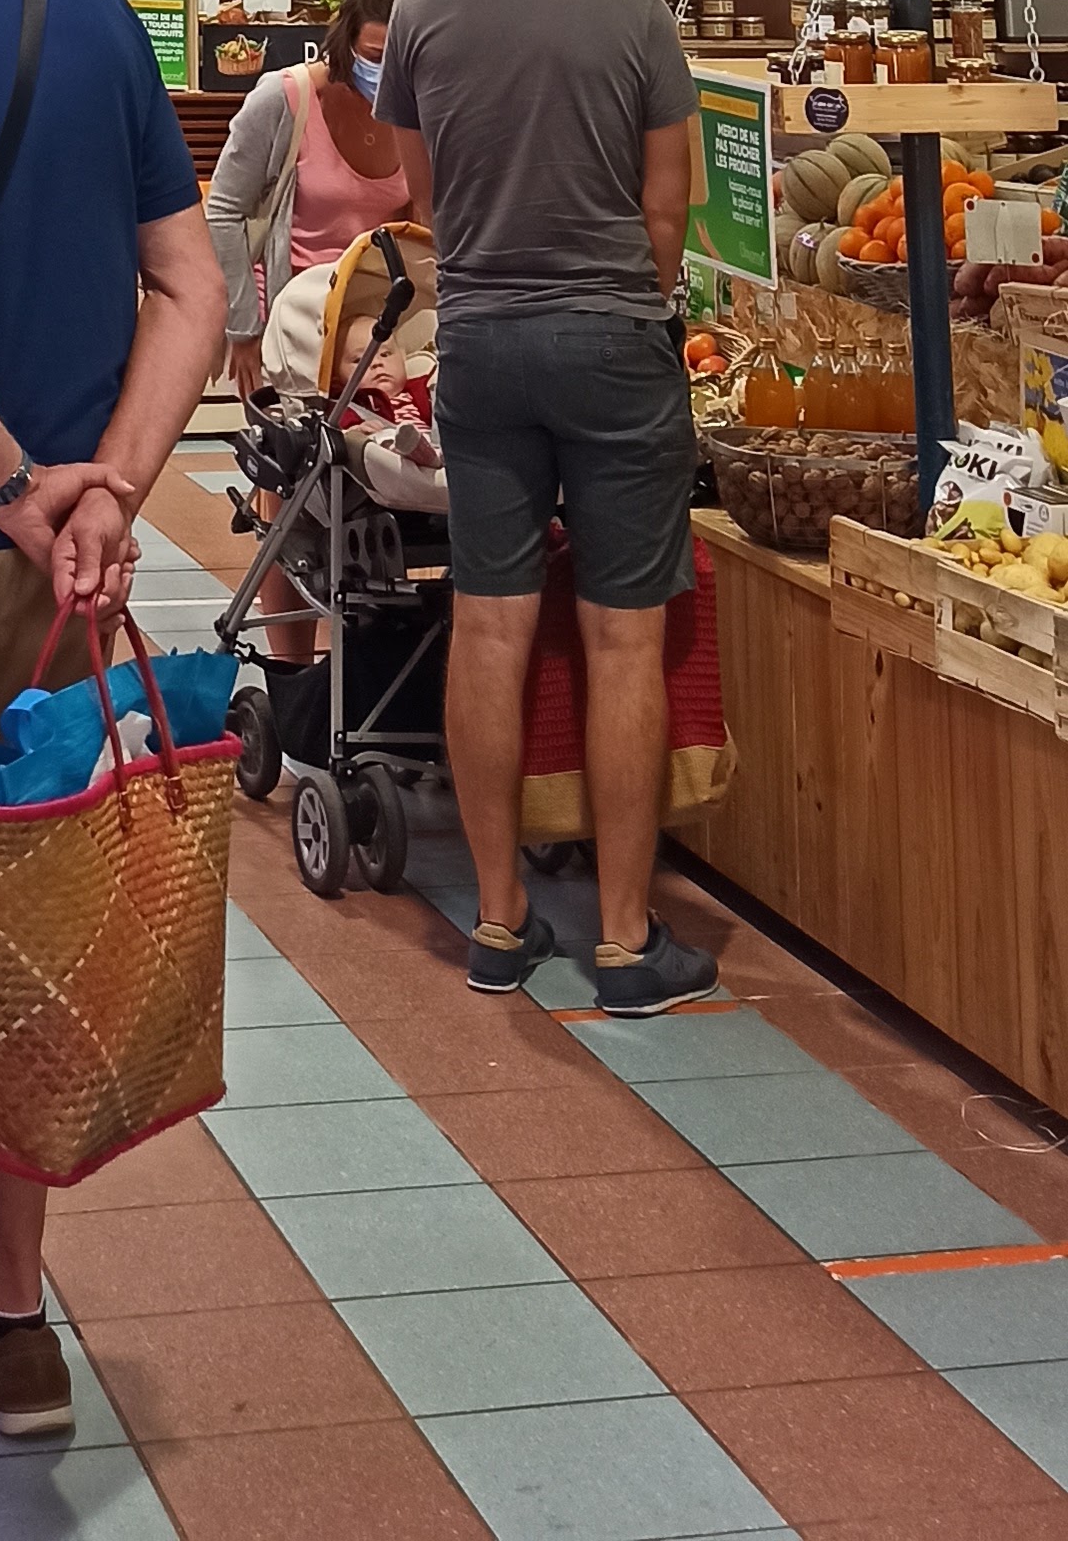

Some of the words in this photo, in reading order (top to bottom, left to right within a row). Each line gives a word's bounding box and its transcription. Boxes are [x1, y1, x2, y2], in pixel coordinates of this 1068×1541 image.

[717, 121, 738, 140] MERCI
[739, 127, 749, 143] DE
[749, 130, 760, 146] NE
[715, 137, 728, 154] PAS
[729, 140, 760, 163] TOUCHER
[715, 152, 728, 169] LES
[728, 156, 761, 179] PRODUITS
